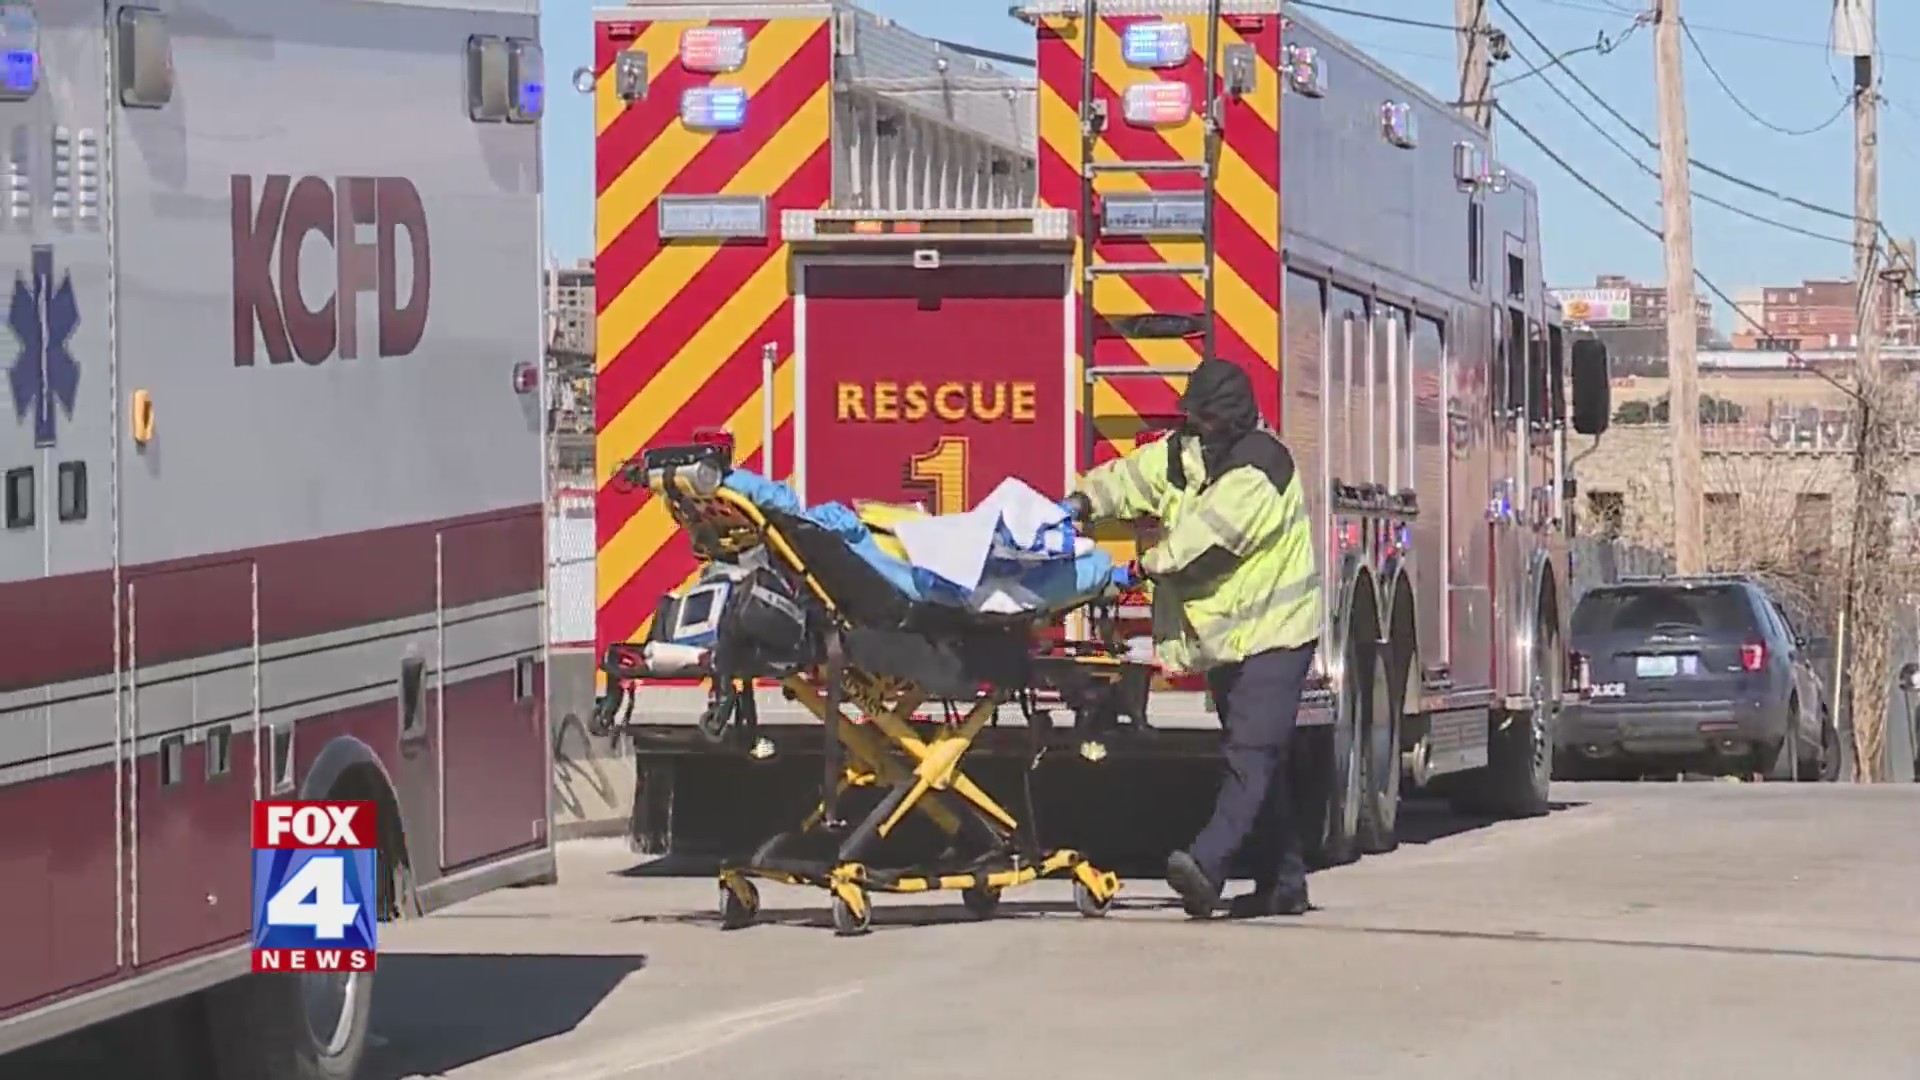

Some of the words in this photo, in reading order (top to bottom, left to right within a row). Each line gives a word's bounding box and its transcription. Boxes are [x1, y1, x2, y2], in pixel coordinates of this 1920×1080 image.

[231, 174, 431, 366] KCFD
[836, 381, 1037, 423] RESCUE
[908, 435, 970, 516] 1
